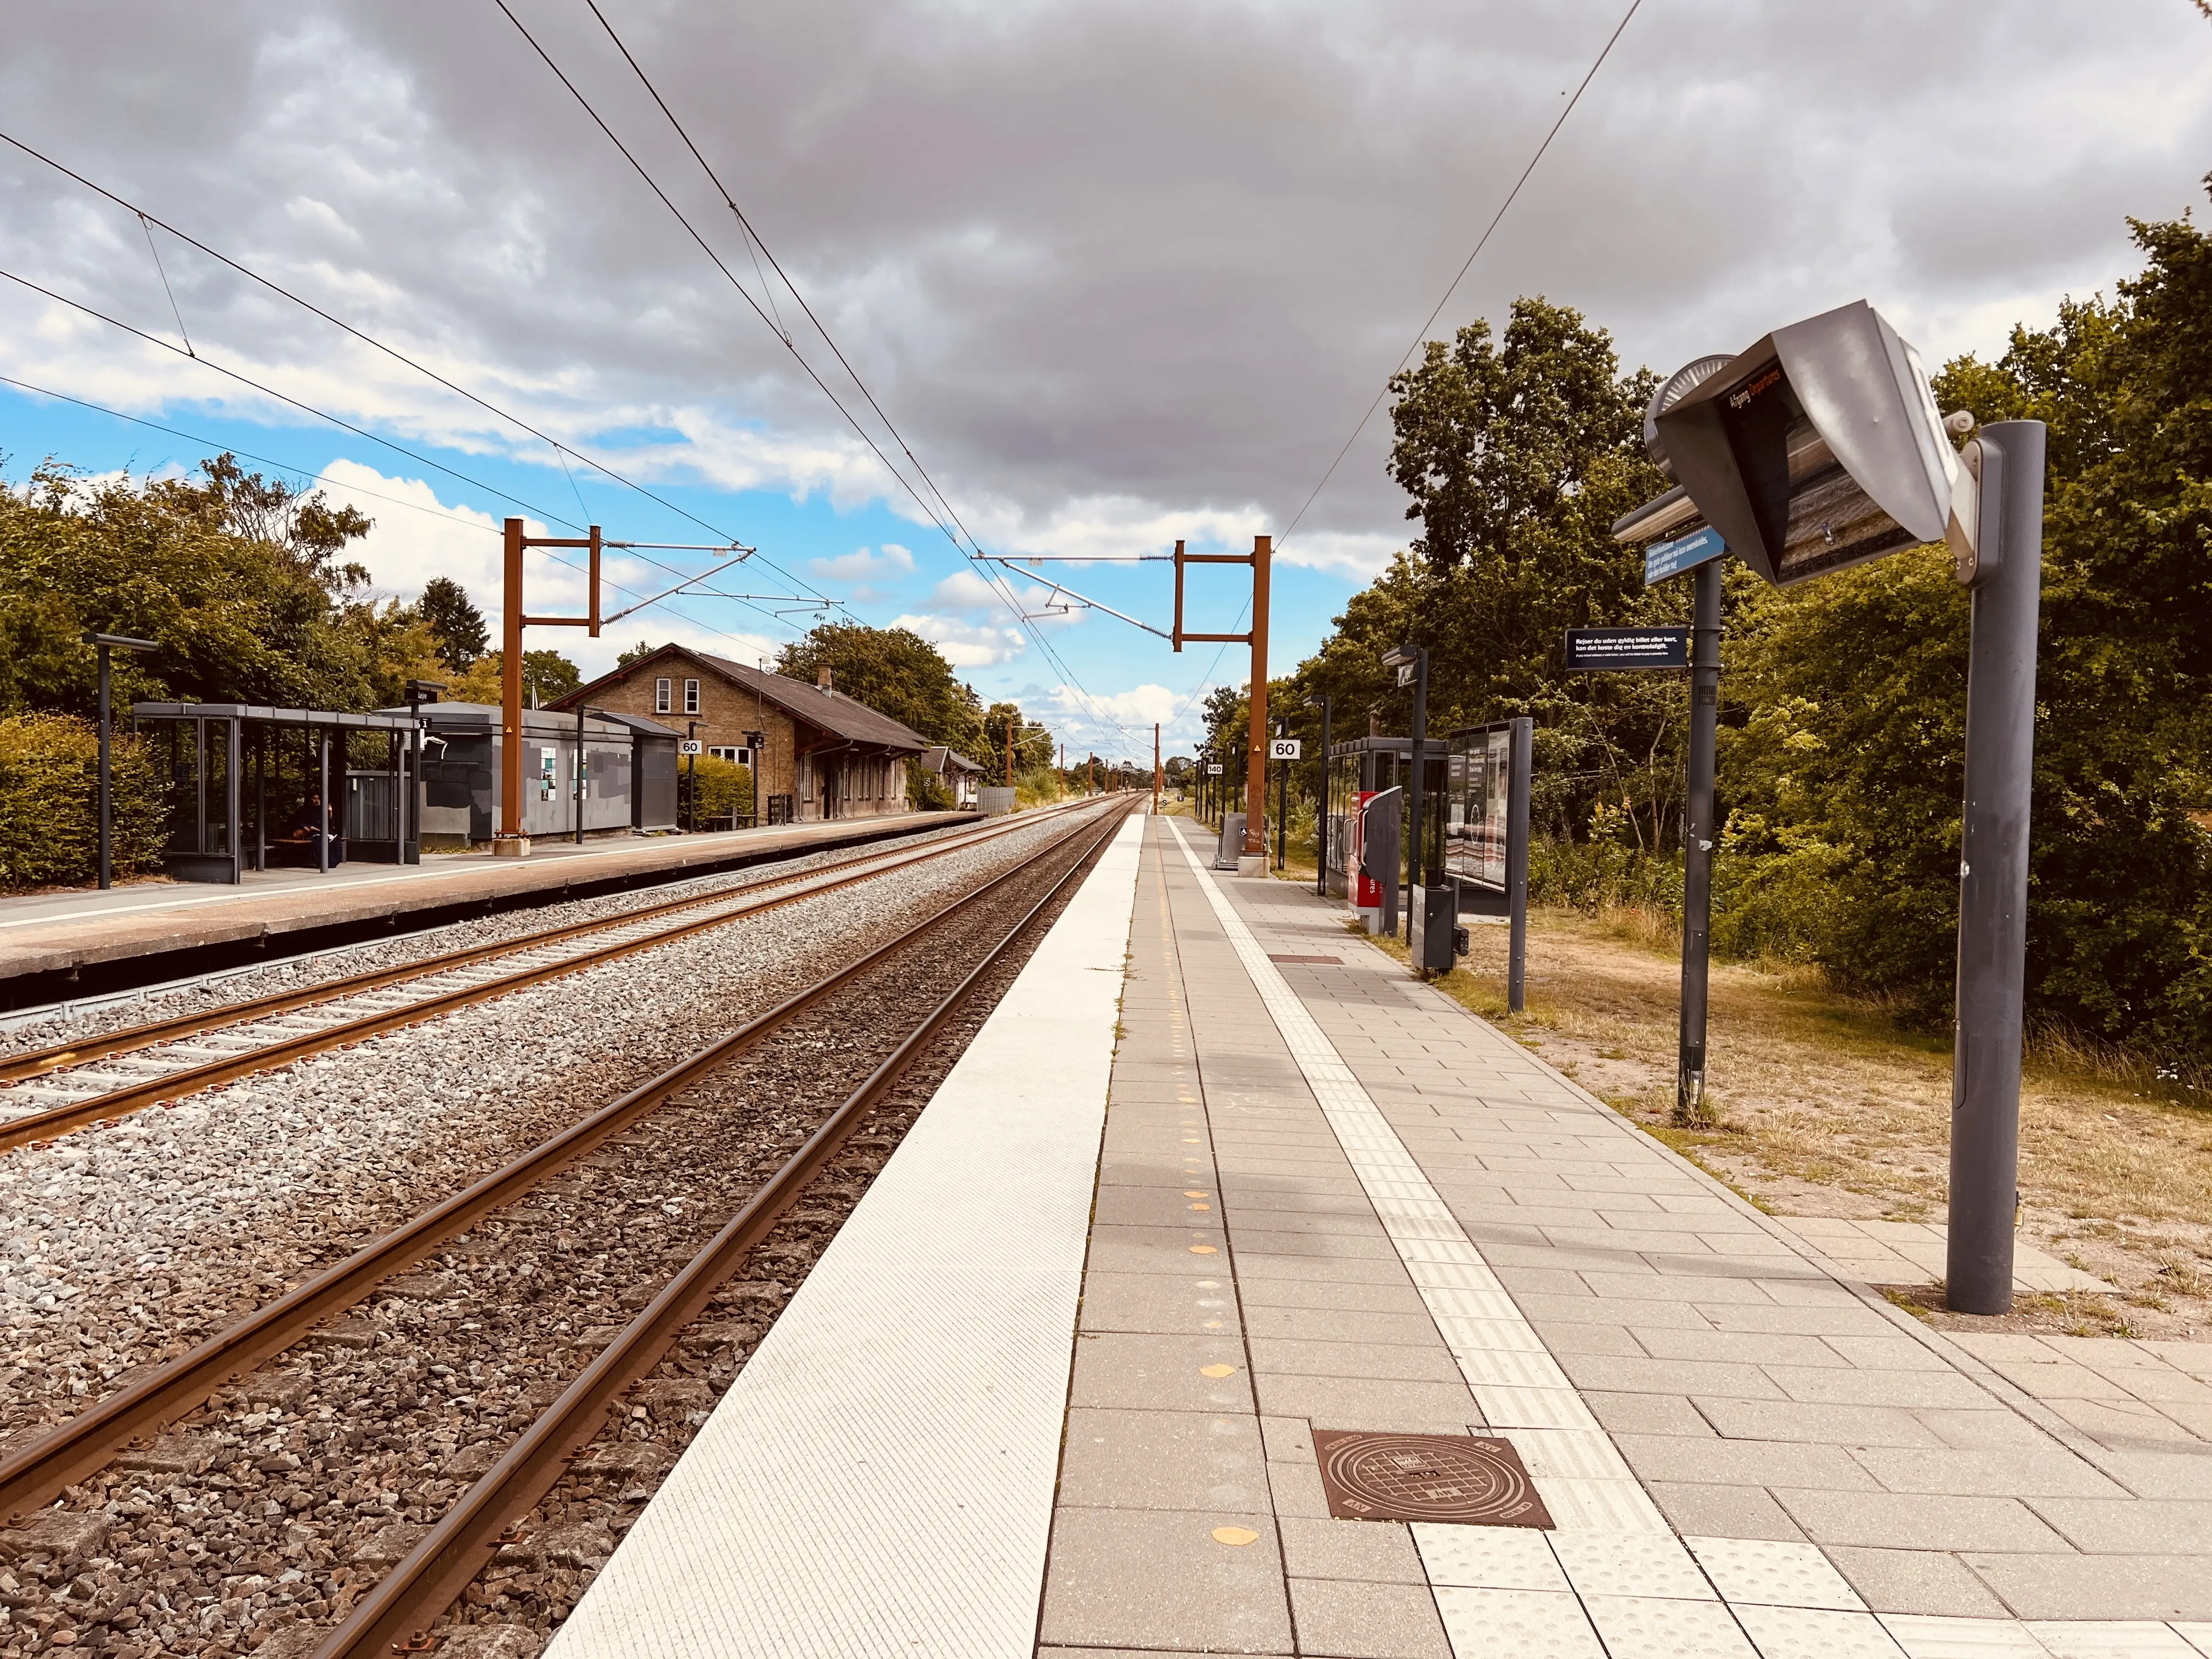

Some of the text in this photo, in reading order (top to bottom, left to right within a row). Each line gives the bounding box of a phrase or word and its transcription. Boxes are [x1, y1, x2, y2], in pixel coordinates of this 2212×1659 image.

[1730, 390, 1751, 409] Afgang
[418, 691, 427, 700] Lejre
[683, 742, 697, 752] 60
[1276, 743, 1295, 755] 60
